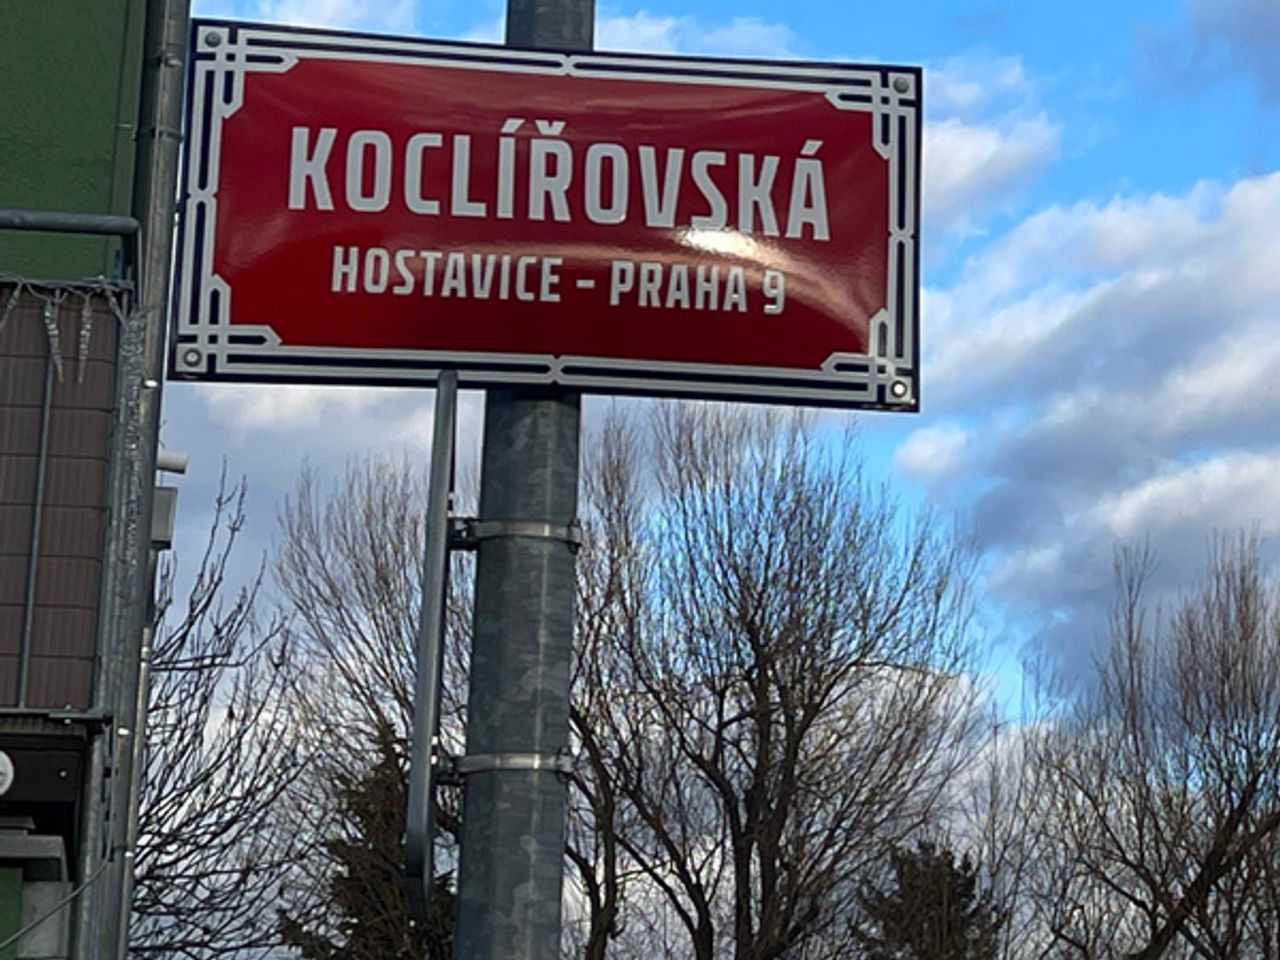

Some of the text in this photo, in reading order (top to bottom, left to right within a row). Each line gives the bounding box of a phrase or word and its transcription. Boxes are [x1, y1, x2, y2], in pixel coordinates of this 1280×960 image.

[288, 119, 830, 241] KOCLÍŘOVSKÁ
[331, 245, 562, 303] HOSTAVICE
[609, 259, 748, 313] PRAHA
[762, 269, 786, 315] 9
